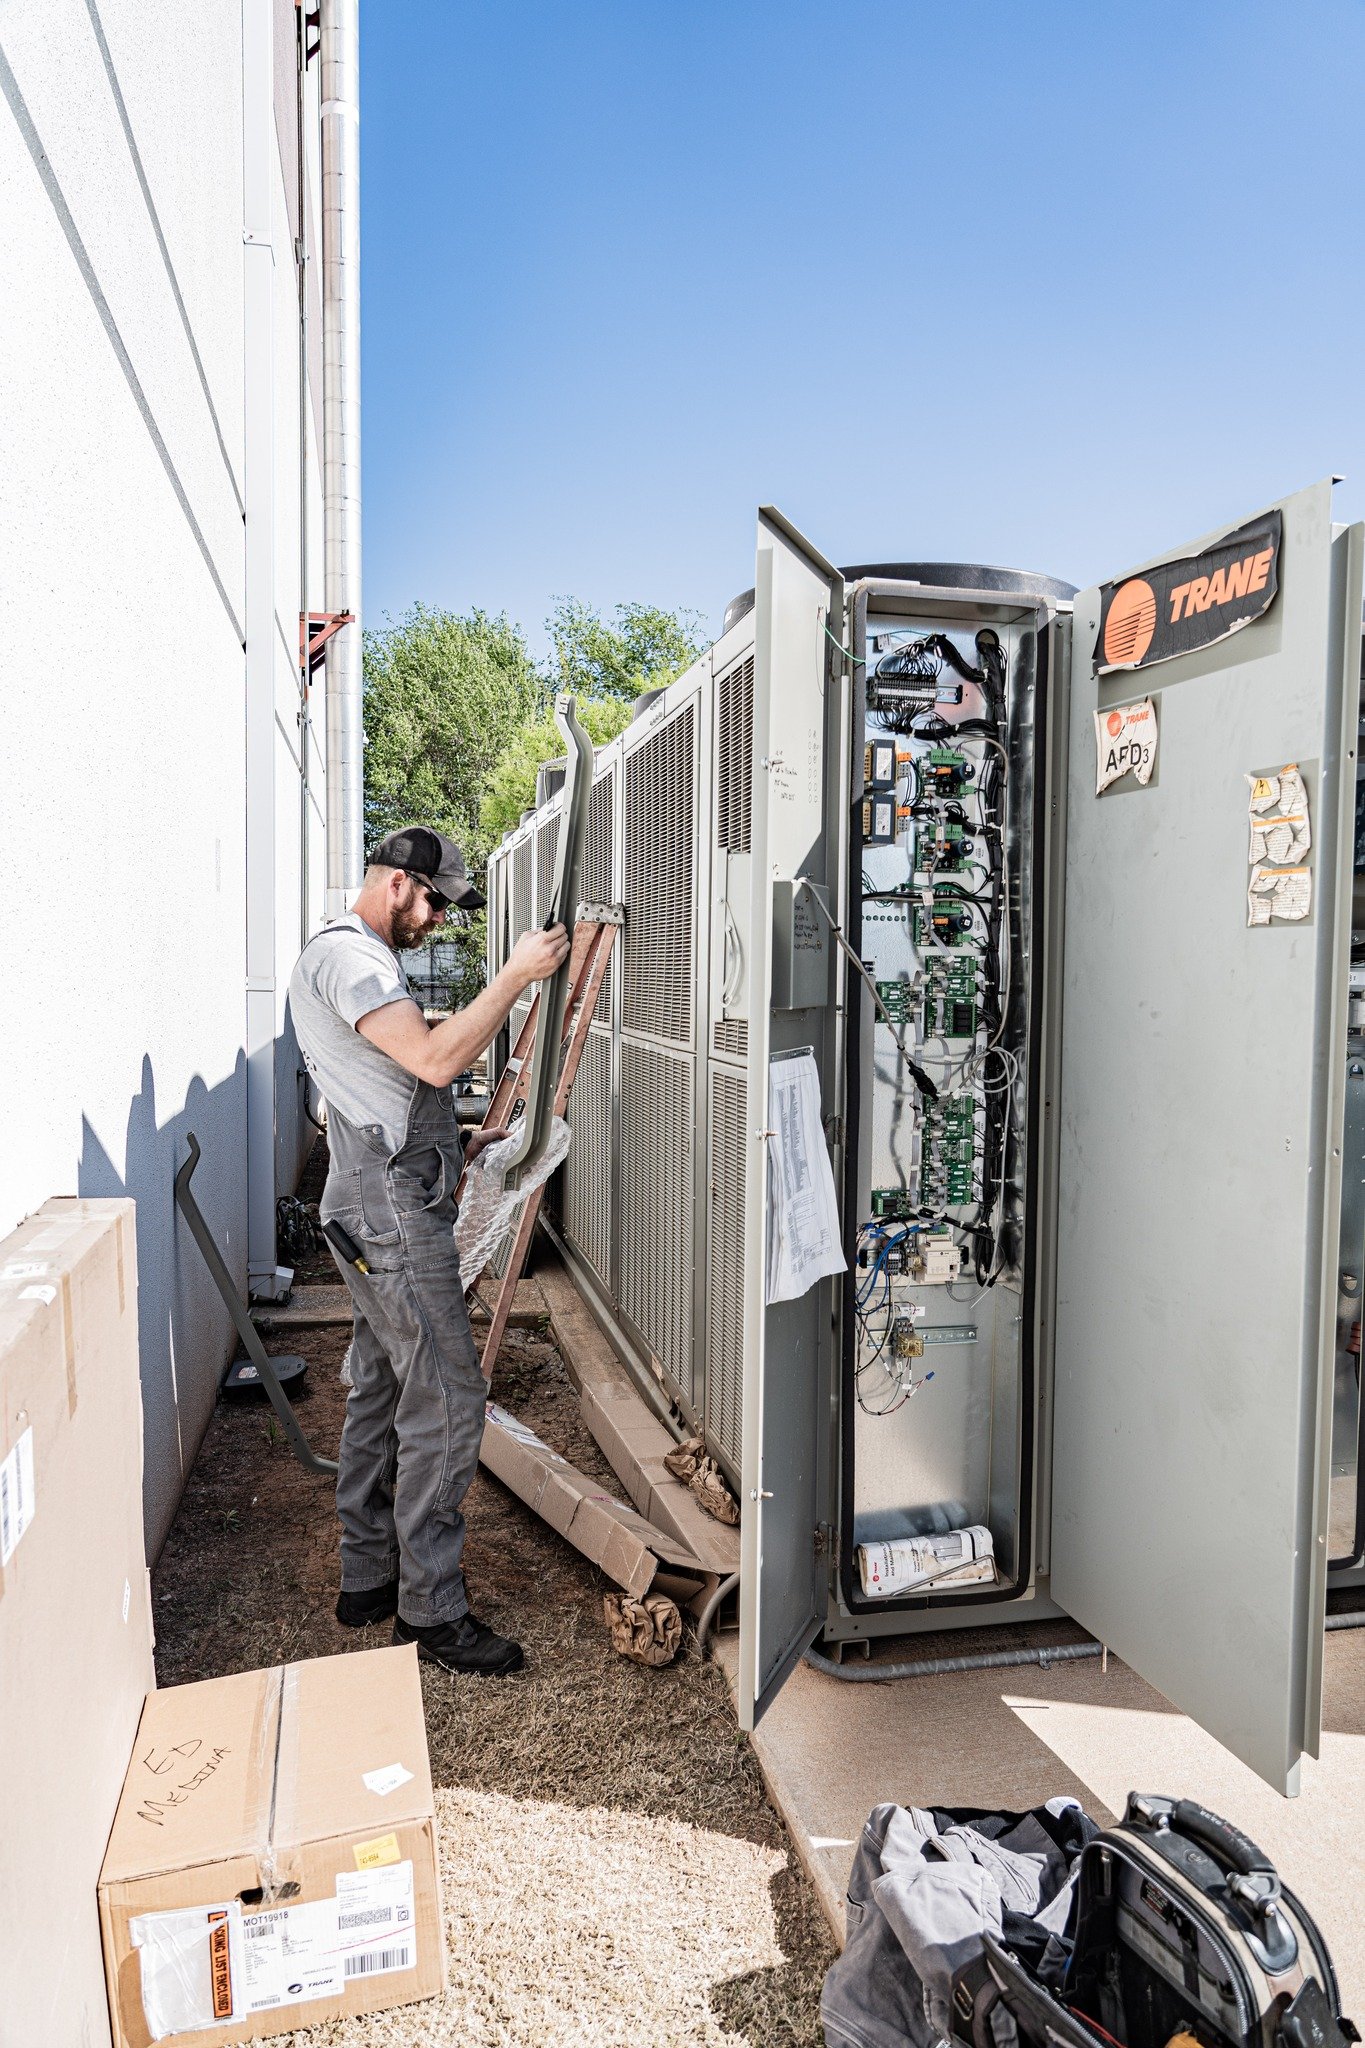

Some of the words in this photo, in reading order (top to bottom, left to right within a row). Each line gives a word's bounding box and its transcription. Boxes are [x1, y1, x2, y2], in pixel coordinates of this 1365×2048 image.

[1169, 547, 1274, 623] TRANE
[1125, 710, 1150, 725] TRANE
[142, 1738, 203, 1775] ED
[136, 1745, 232, 1826] MEDINA
[243, 1910, 289, 1928] MOT19918
[215, 1954, 227, 1972] LIST
[216, 1974, 229, 2011] ENCLOSED
[308, 1978, 334, 1988] TRANE
